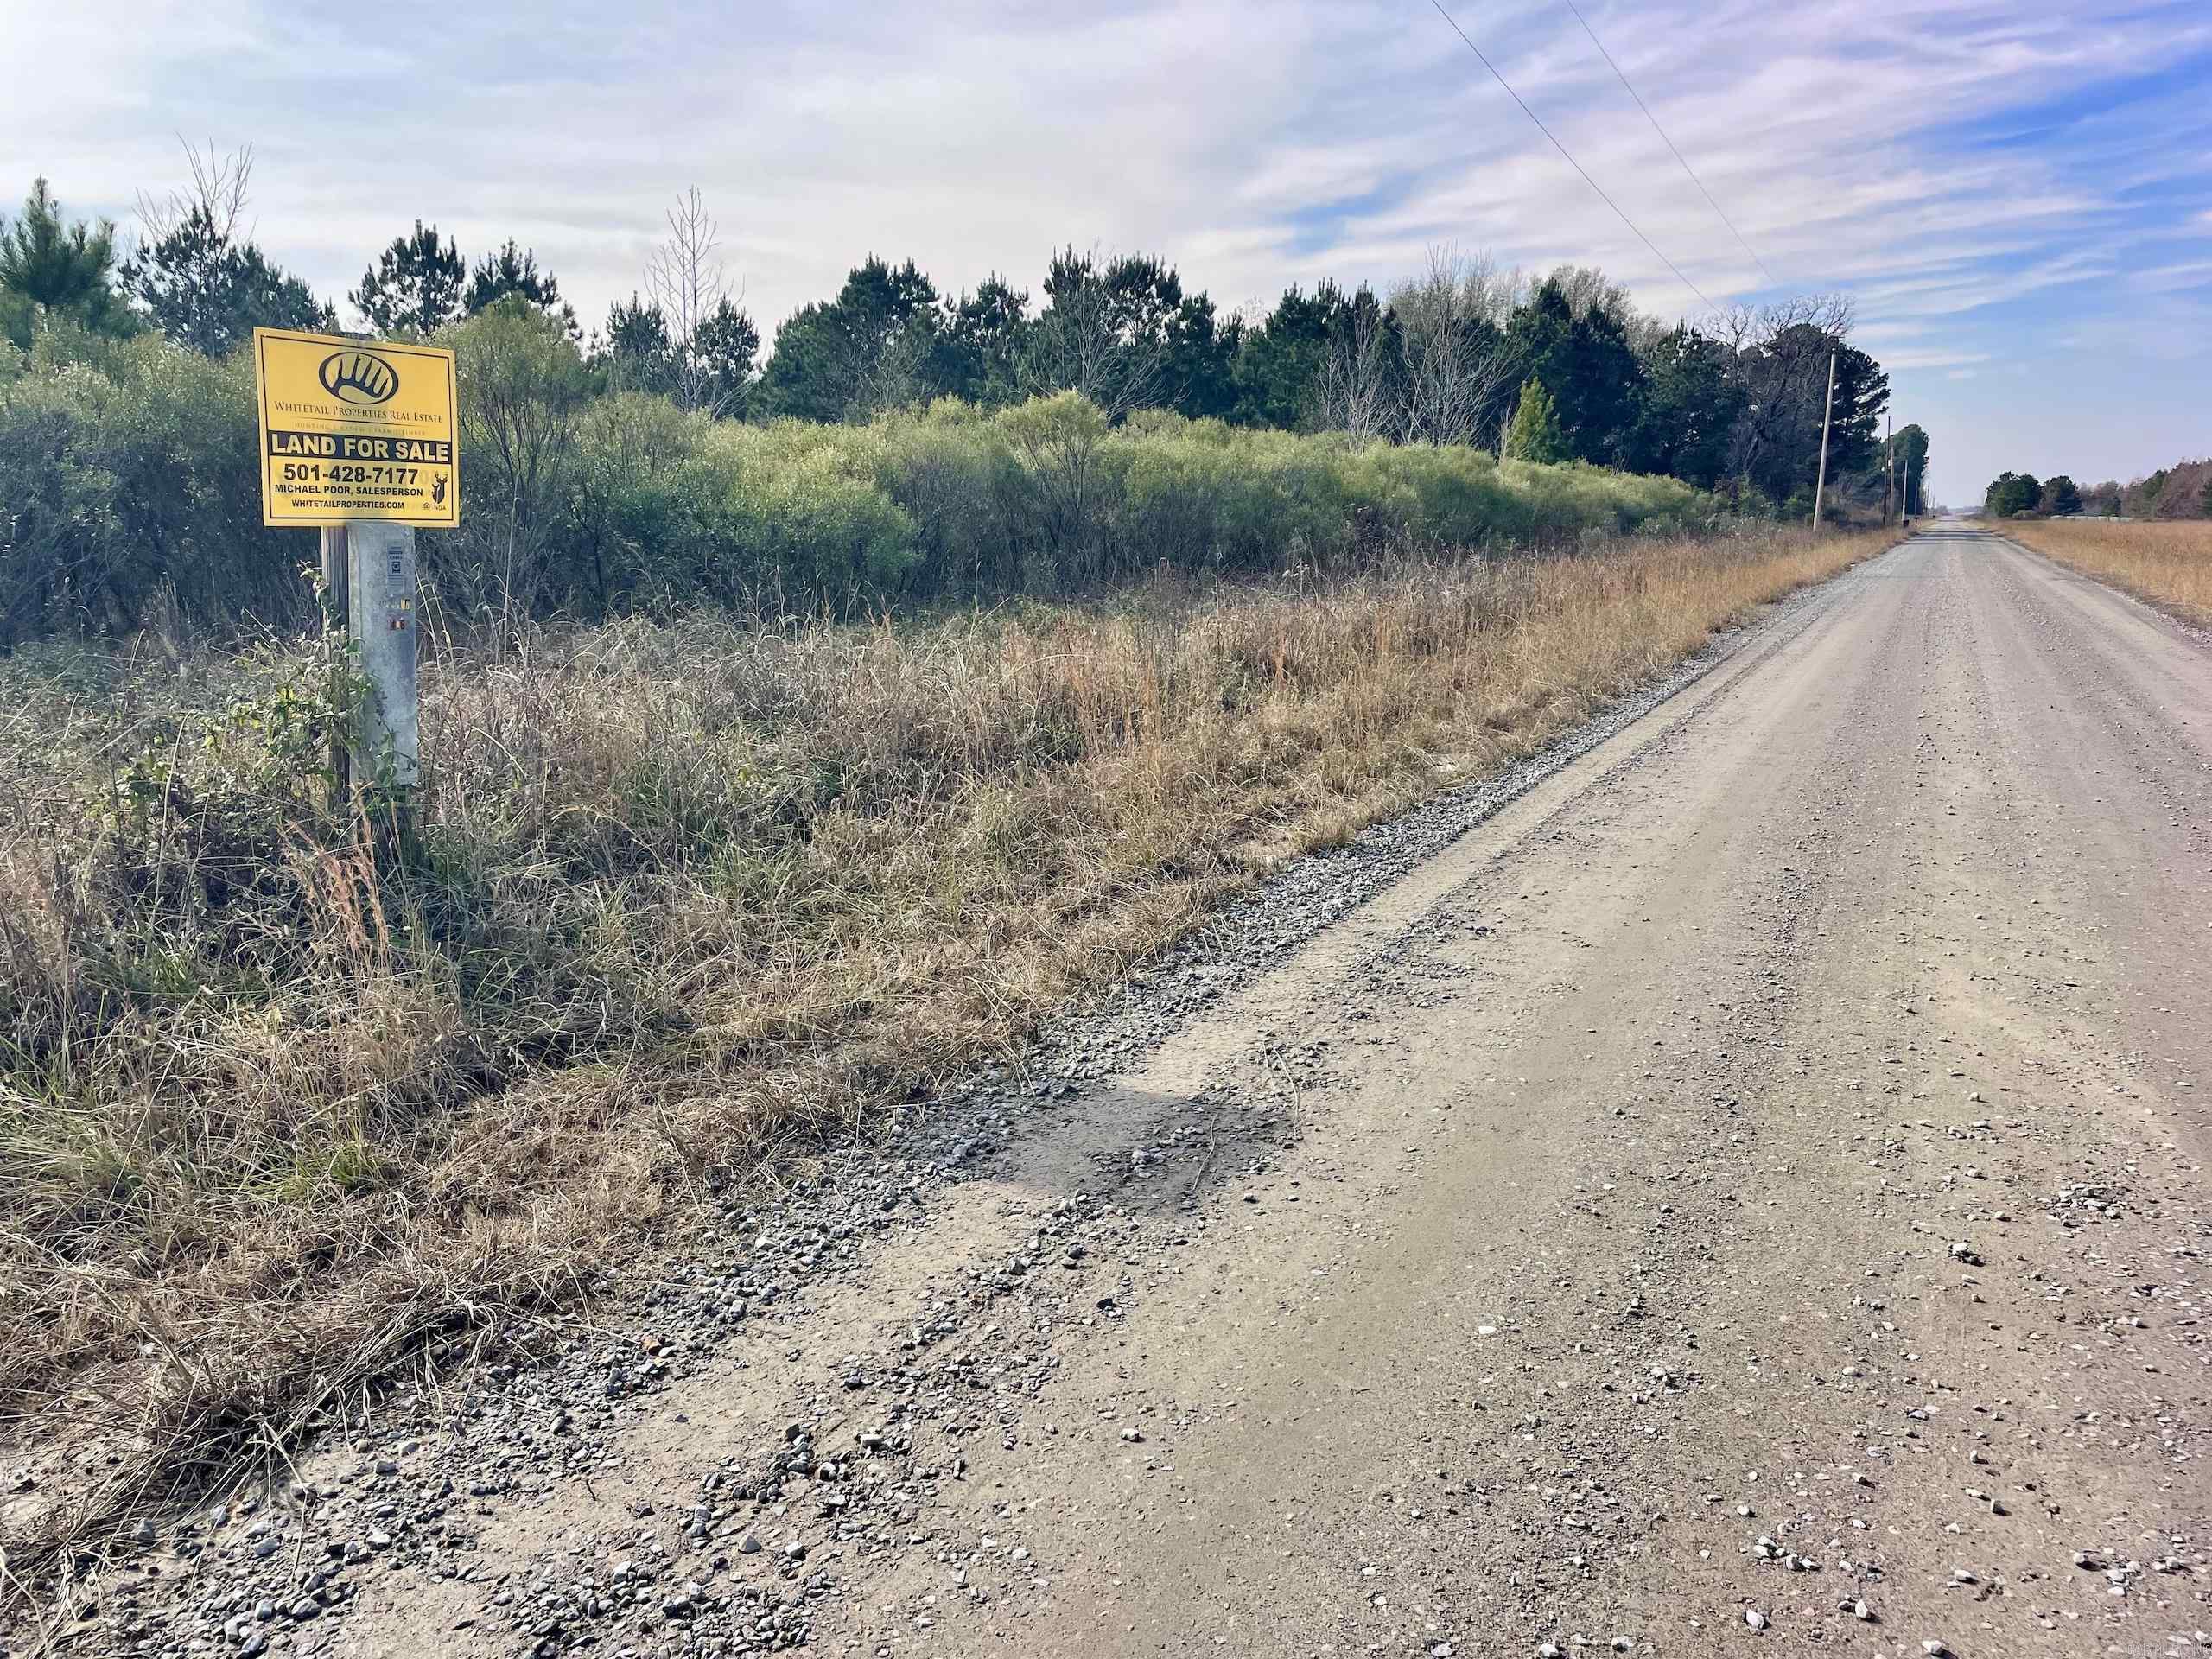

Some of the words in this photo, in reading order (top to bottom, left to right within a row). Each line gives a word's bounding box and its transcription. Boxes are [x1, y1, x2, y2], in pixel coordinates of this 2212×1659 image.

[274, 401, 328, 415] WHITETAIL
[332, 405, 387, 419] PROPERTIES
[390, 410, 410, 421] REAL
[414, 412, 442, 423] ESTATE
[271, 433, 336, 456] LAND
[344, 438, 389, 459] FOR
[395, 441, 448, 461] SALE
[283, 463, 419, 485] 501-428-7177
[275, 484, 321, 493] MICHAEL
[324, 486, 353, 496] POOR,
[356, 486, 423, 497] SALESPERSON
[291, 499, 404, 510] WHITETAILPROPERTIES.COM
